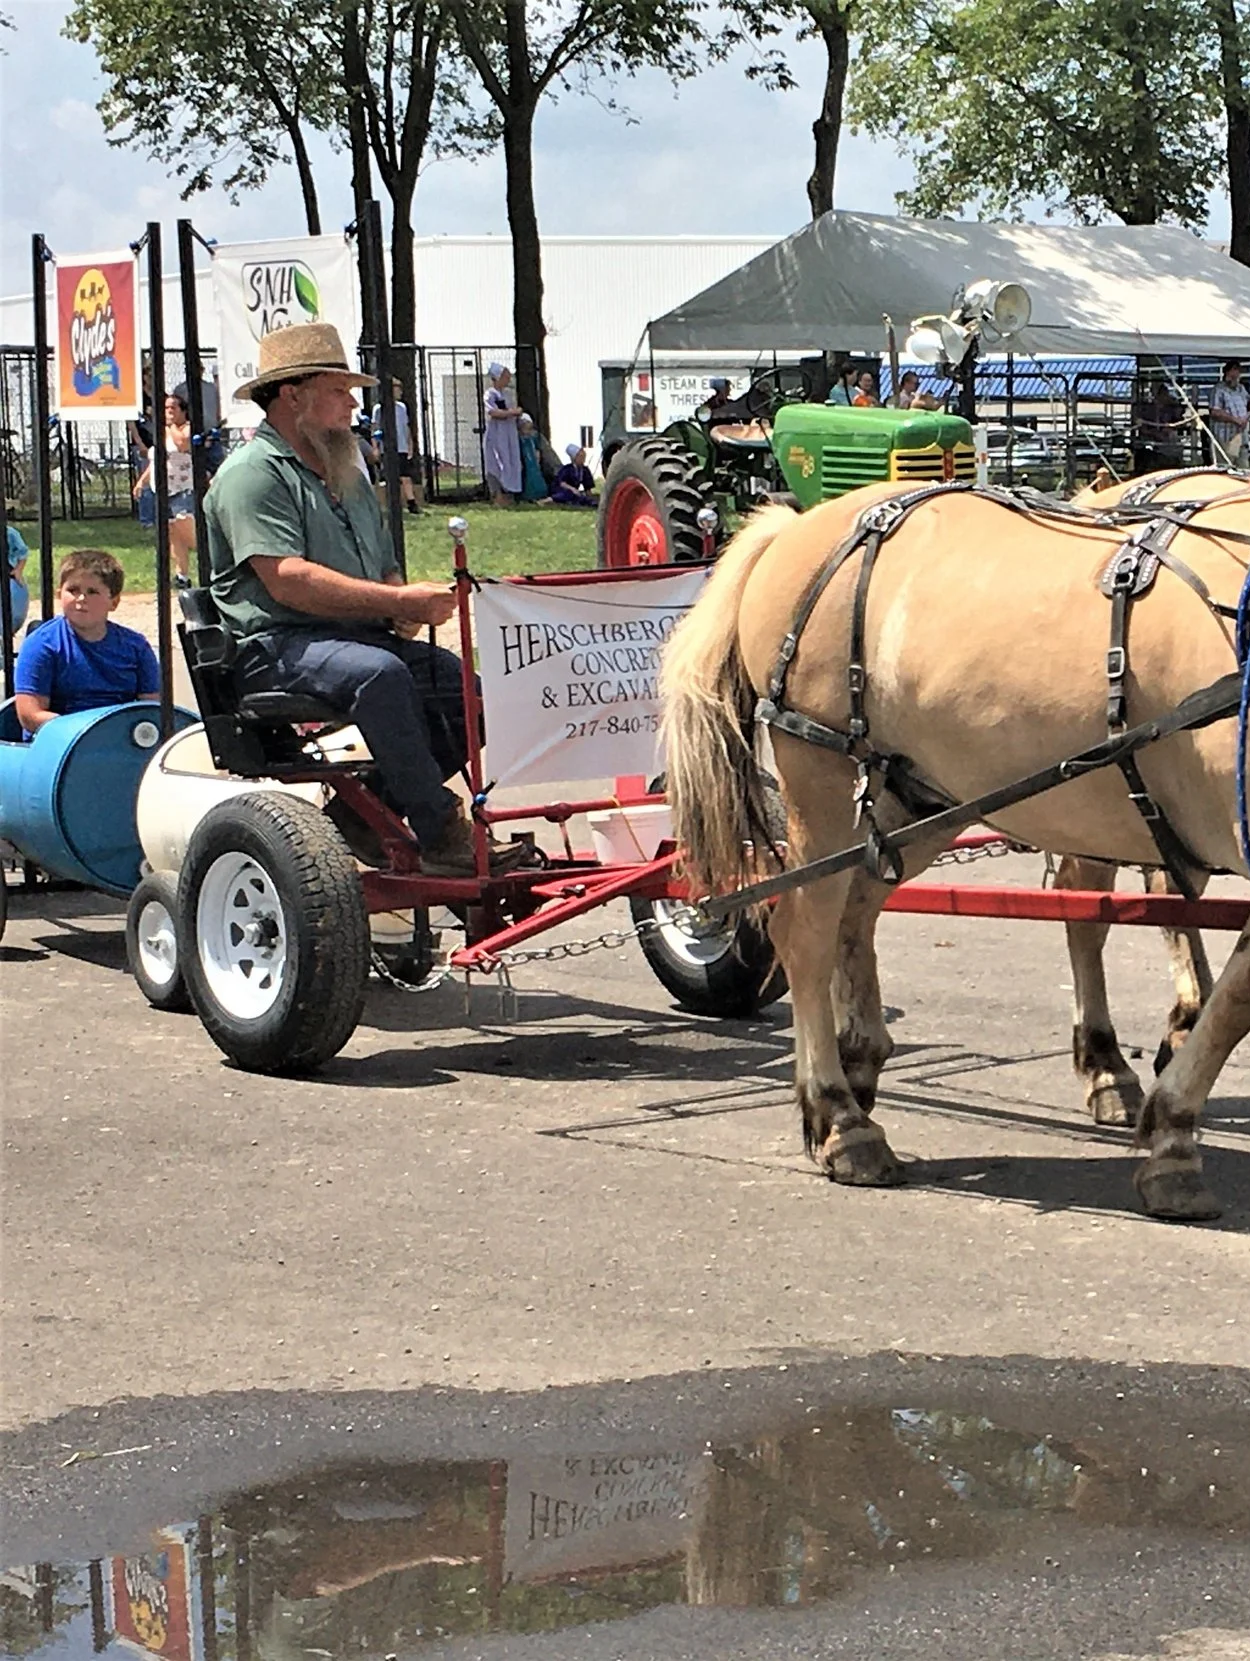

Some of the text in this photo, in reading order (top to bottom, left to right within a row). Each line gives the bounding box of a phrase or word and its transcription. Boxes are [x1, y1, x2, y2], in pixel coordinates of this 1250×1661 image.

[246, 266, 294, 312] SNH
[71, 304, 115, 376] Clyde's
[235, 362, 254, 379] Call
[660, 378, 697, 390] STEAM
[671, 393, 709, 406] THRES
[499, 613, 688, 675] HERSCHBERG
[571, 647, 662, 676] CONCRET
[541, 676, 660, 709] & EXCAVAT
[566, 714, 659, 739] 217-840-75
